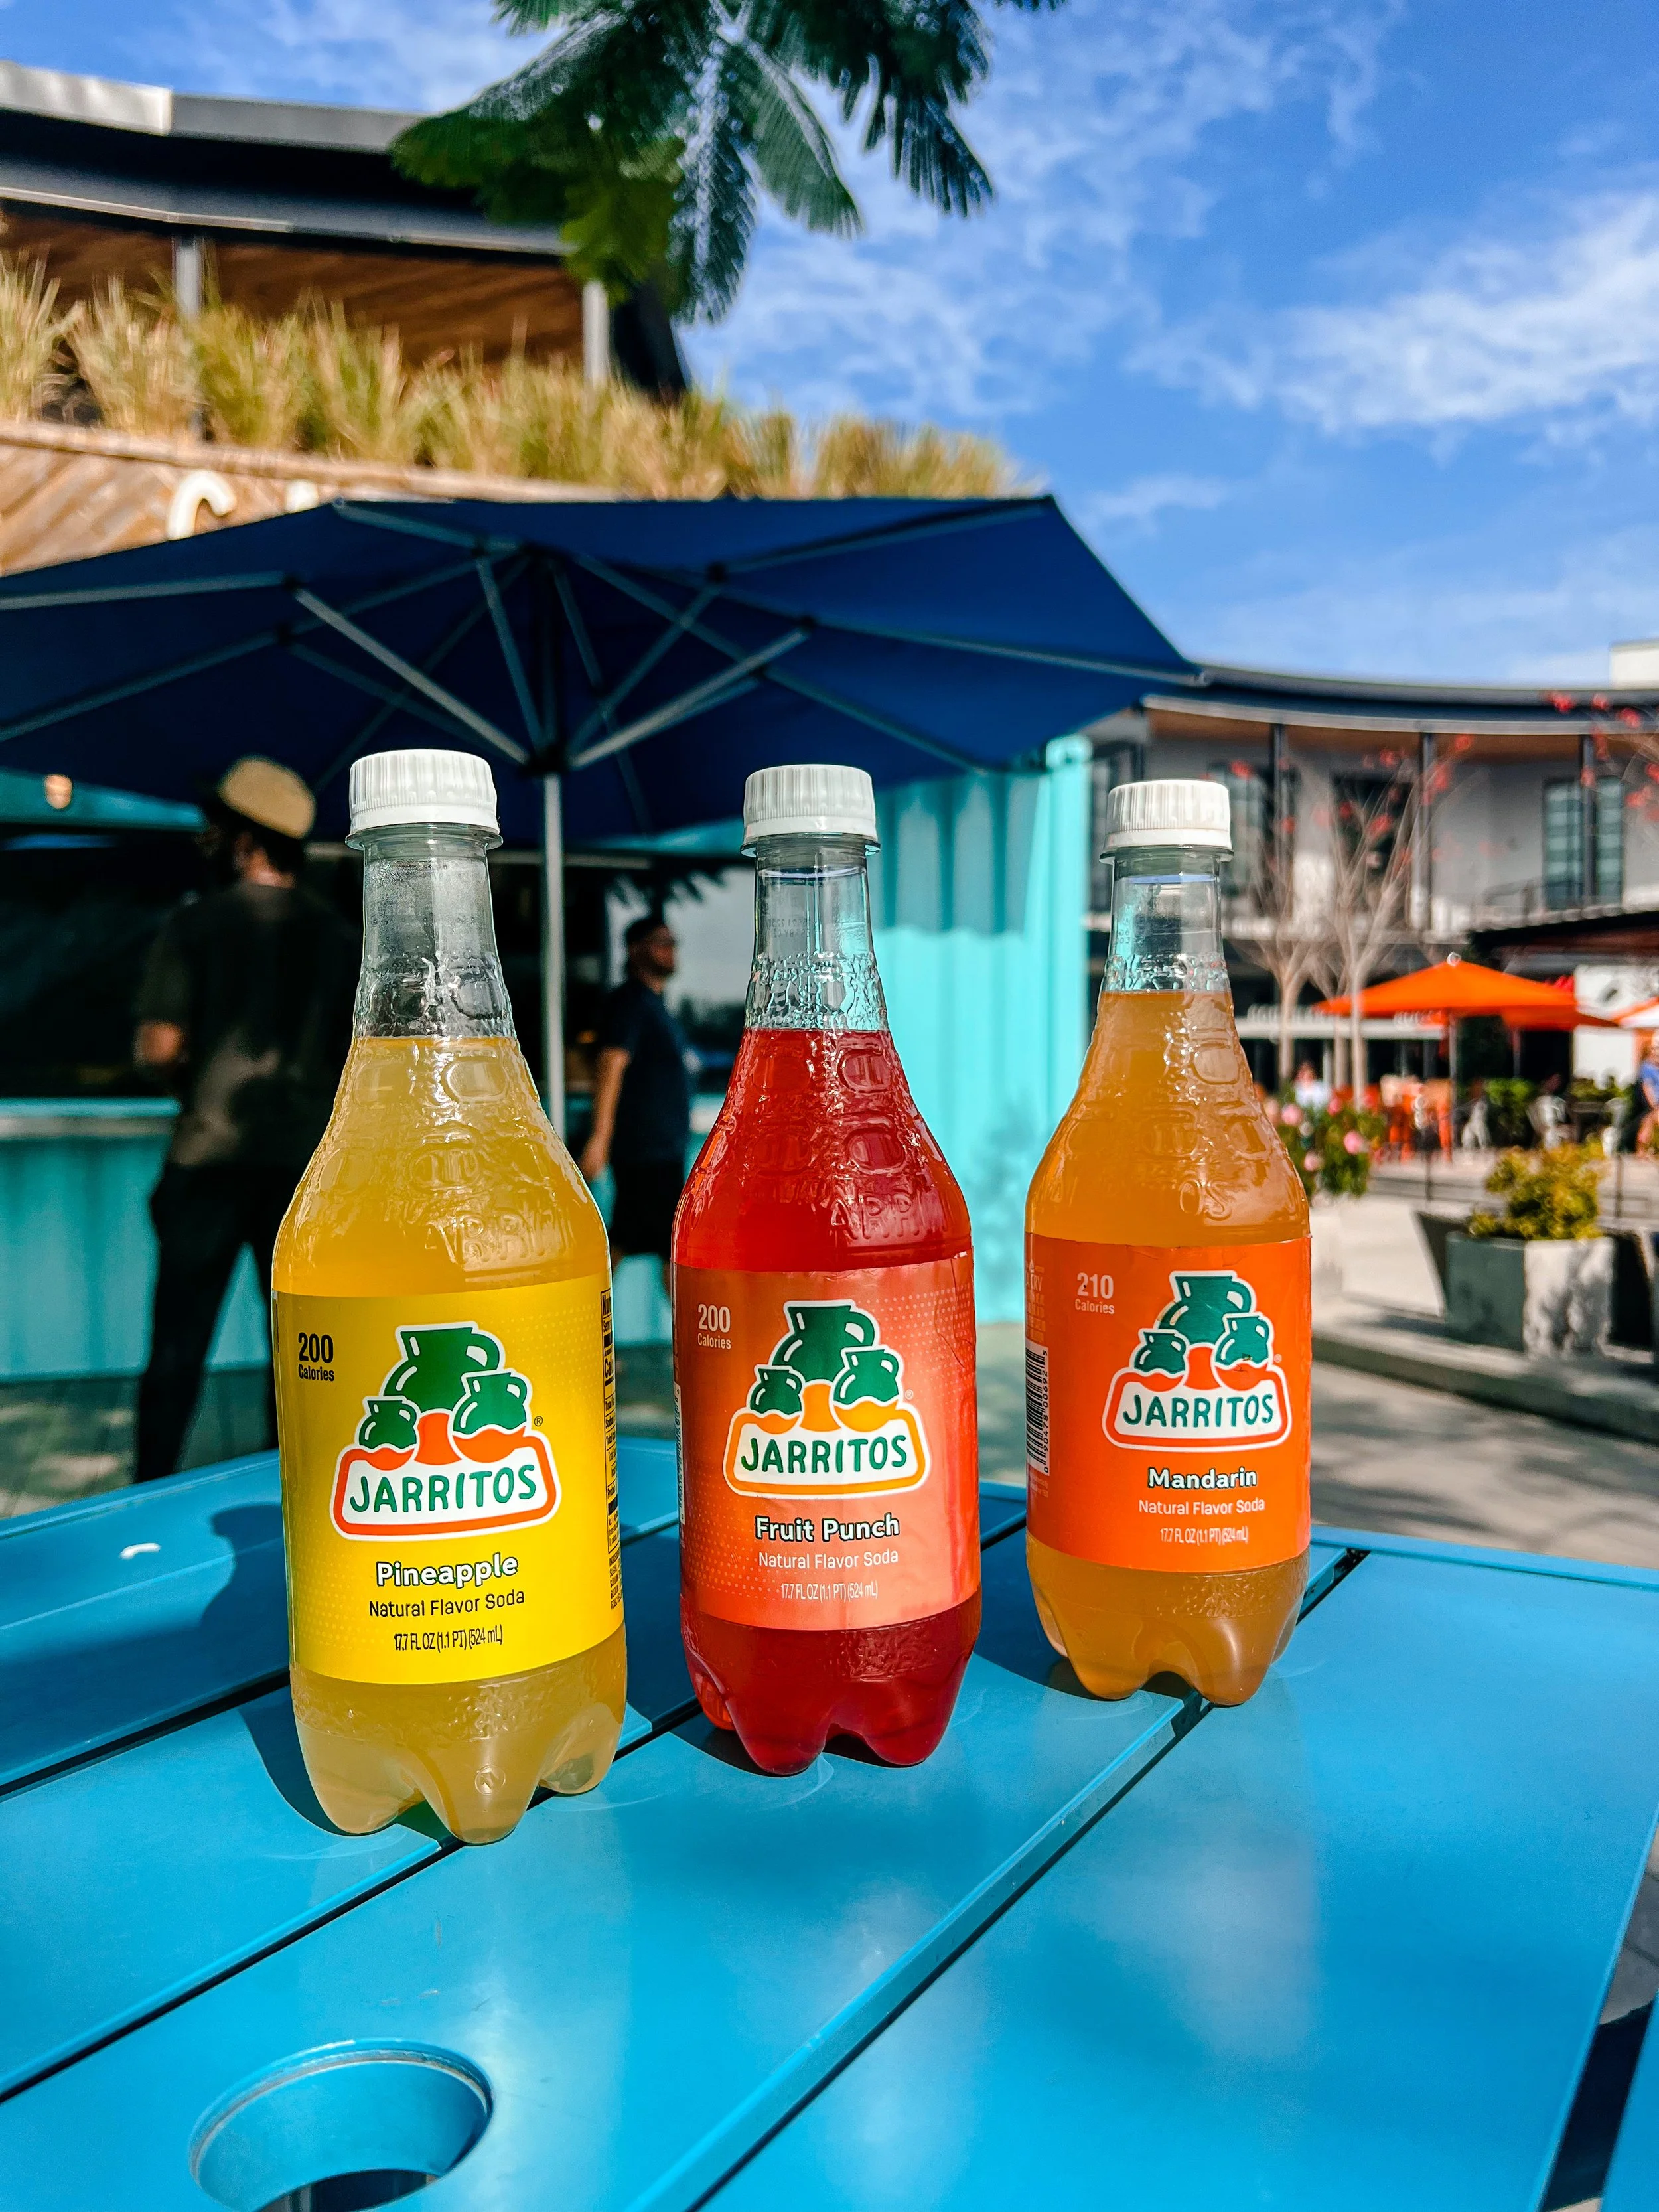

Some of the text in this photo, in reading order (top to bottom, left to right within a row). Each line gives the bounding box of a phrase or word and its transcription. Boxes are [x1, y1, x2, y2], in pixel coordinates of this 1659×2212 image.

[1076, 1272, 1114, 1300] 210
[697, 1303, 731, 1333] 200
[1074, 1299, 1115, 1315] Calories
[297, 1332, 334, 1364] 200
[697, 1333, 731, 1350] Calories
[297, 1364, 335, 1382] Calories
[1123, 1393, 1274, 1428] JARRITOS
[741, 1434, 907, 1474] JARRITOS
[349, 1463, 537, 1513] JARRITOS
[1147, 1467, 1258, 1489] Mandarin
[1139, 1497, 1265, 1516] Natural Flavor Soda
[755, 1512, 900, 1542] Fruit Punch
[1160, 1528, 1173, 1542] 17.7
[1174, 1528, 1184, 1543] FL
[1185, 1528, 1196, 1544] OZ
[376, 1552, 520, 1589] Pineapple
[758, 1548, 899, 1570] Natural Flavor Soda
[368, 1589, 525, 1618] Natural Flavor Soda
[781, 1580, 878, 1603] 17.7 FL OZ (1.1 PT) (524 mL)
[394, 1623, 503, 1653] 17.7 FL OZ (1.1 PT) (524 mL)
